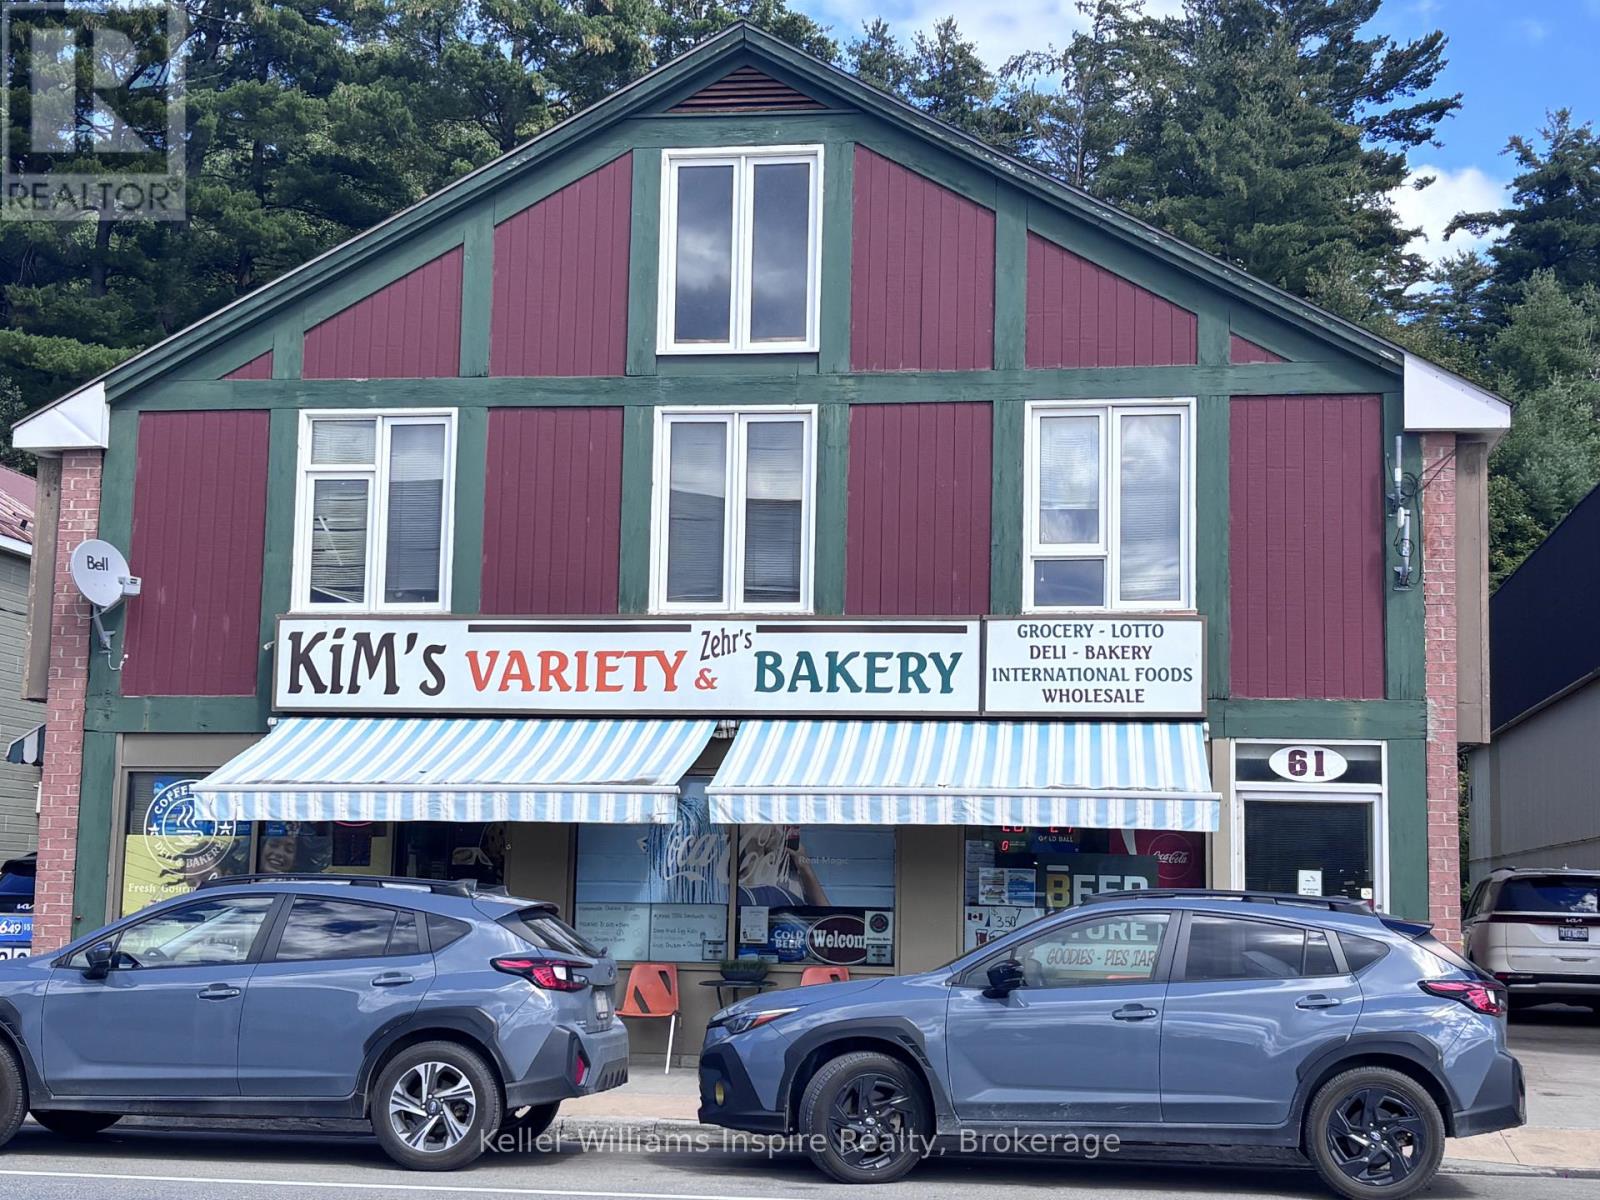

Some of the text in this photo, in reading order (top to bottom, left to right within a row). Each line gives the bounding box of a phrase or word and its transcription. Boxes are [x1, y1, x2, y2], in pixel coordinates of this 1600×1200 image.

[86, 555, 109, 571] Bell
[1017, 623, 1094, 639] GROCERY
[1111, 623, 1165, 639] LOTTO
[699, 627, 752, 661] Zehr's
[1029, 645, 1067, 660] DELI
[1085, 645, 1153, 660] BAKERY
[287, 627, 963, 697] KiM's VARIETY & BAKERY
[992, 667, 1193, 682] INTERNATIONAL FOODS
[1042, 688, 1145, 703] WHOLESALE
[1287, 749, 1325, 777] 61
[153, 784, 194, 815] COFFE
[185, 840, 226, 869] BAKERY
[128, 883, 156, 893] Fresh
[774, 929, 805, 940] COLD
[774, 938, 804, 949] BEER
[1046, 949, 1095, 967] GOODIES
[1104, 949, 1129, 968] PIES
